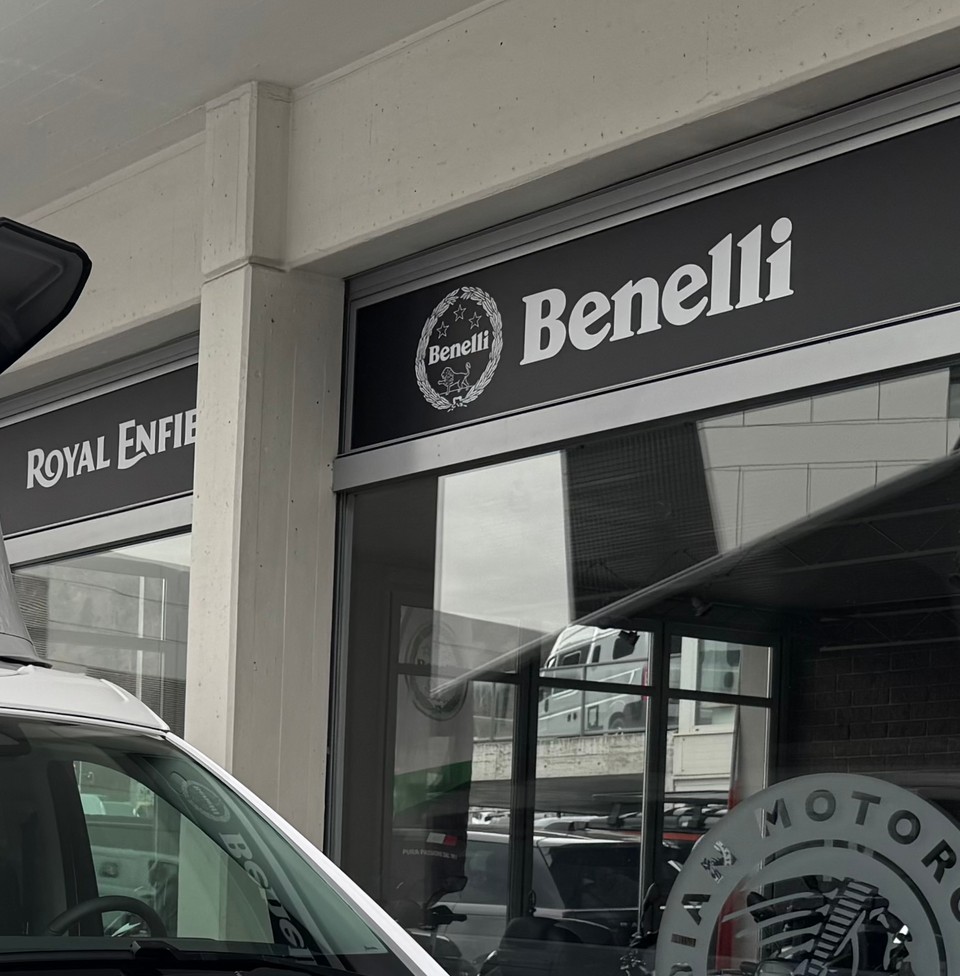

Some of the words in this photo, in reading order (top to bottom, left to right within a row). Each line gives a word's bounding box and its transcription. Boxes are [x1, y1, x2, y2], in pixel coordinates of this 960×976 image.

[520, 217, 795, 366] Benelli
[427, 329, 490, 367] Benelli
[26, 435, 111, 489] ROYAL
